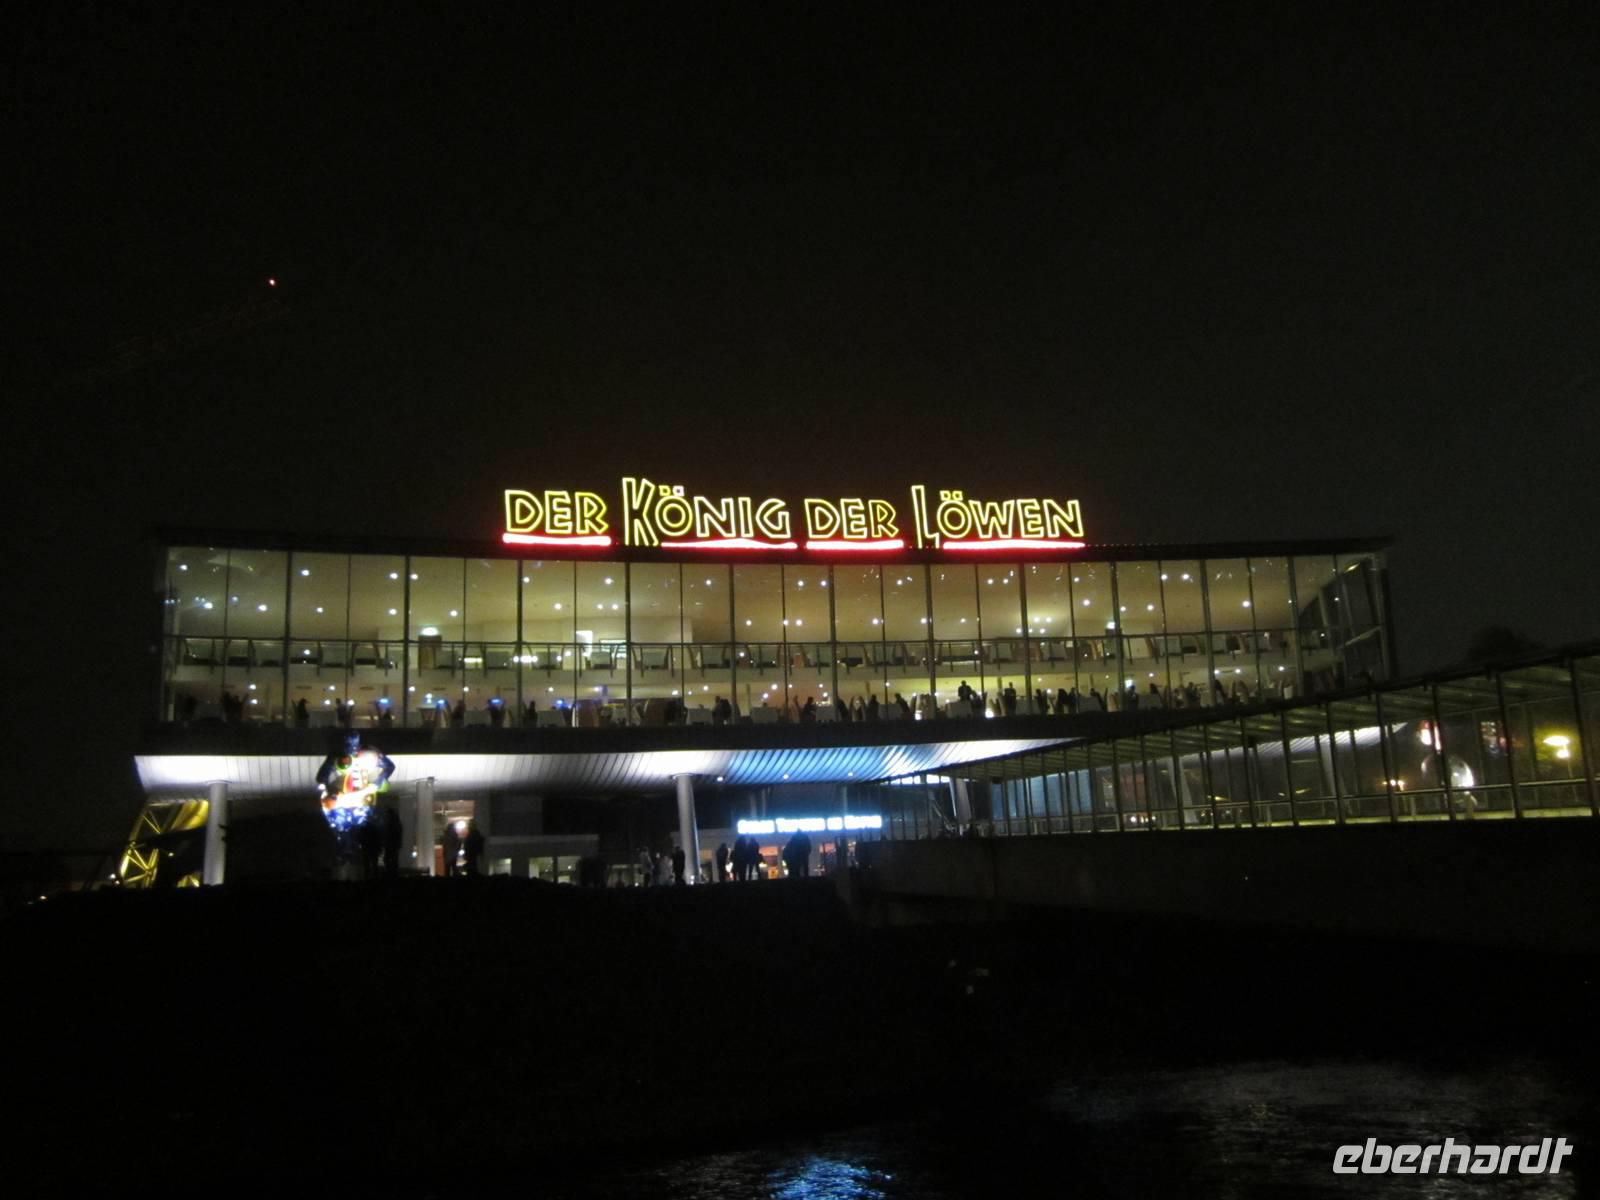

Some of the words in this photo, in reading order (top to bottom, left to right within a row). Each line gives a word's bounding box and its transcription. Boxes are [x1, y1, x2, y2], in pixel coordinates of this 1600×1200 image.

[503, 488, 610, 536] DER
[621, 476, 791, 547] KÖNIG
[803, 496, 899, 540] DER
[911, 484, 1085, 549] LÖWEN
